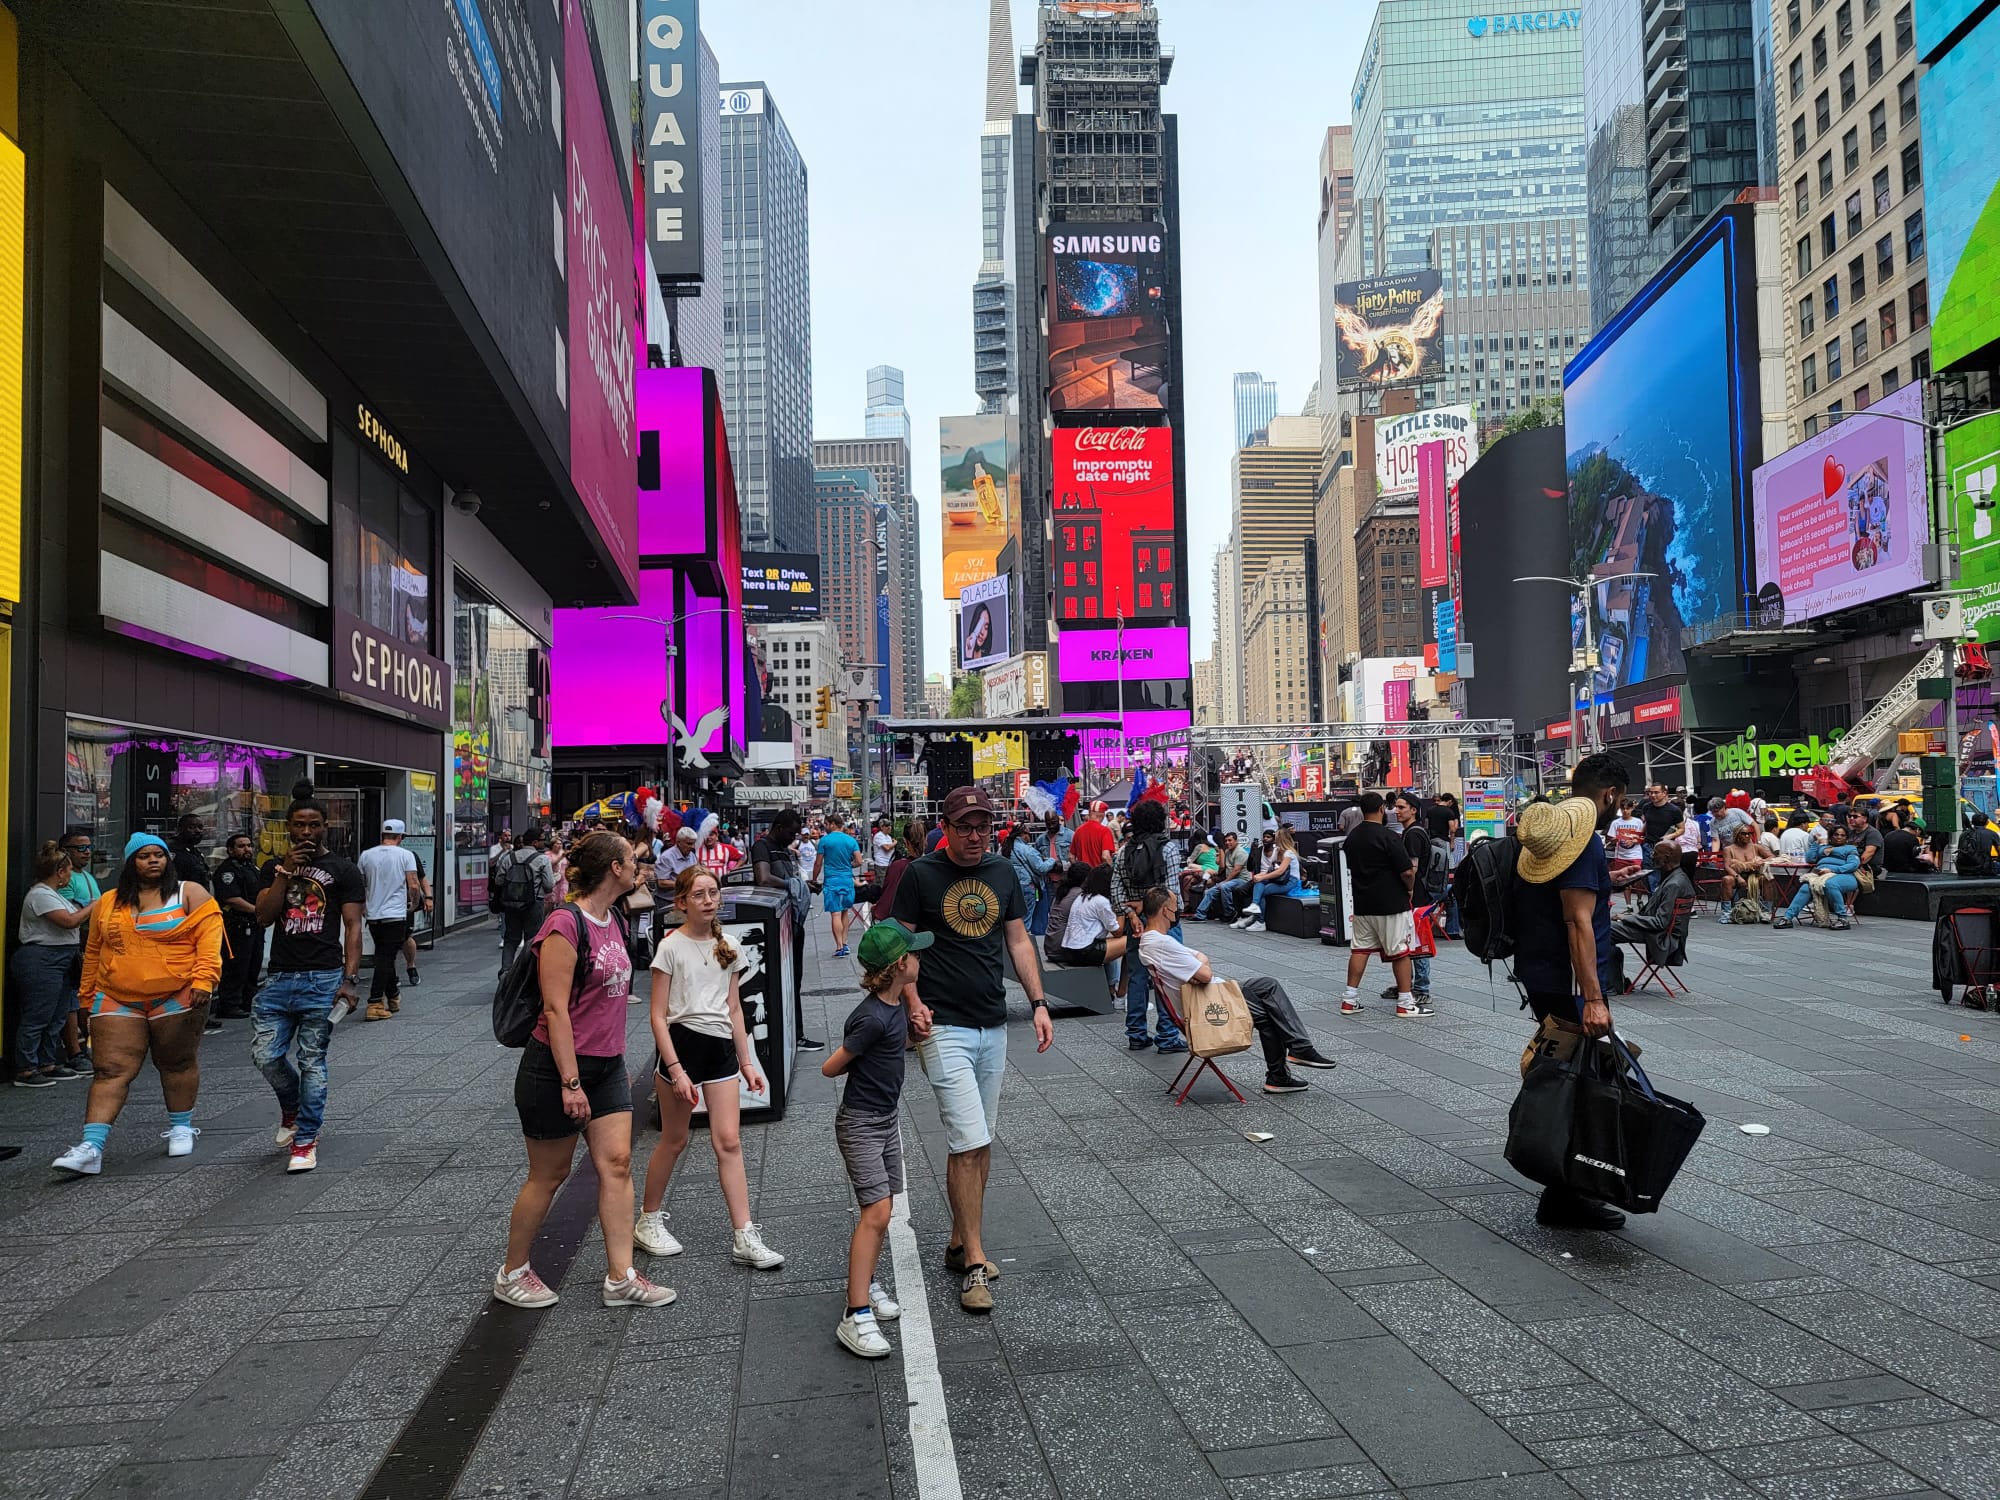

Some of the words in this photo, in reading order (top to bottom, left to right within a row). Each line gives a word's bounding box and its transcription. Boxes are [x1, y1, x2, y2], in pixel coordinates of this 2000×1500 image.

[647, 0, 686, 242] QUARE
[572, 141, 608, 339] PRICE
[1052, 235, 1162, 254] SAMSUNG
[1374, 276, 1418, 288] BROADWAY
[1356, 292, 1387, 315] Harry
[1387, 288, 1423, 312] Potter
[610, 277, 635, 423] LOCK
[587, 300, 629, 459] GUARANTEE
[357, 404, 408, 474] SEPHORA
[1074, 426, 1149, 452] Coca-Cola
[1385, 413, 1430, 445] LITTLE
[1433, 413, 1468, 433] SHOP
[1073, 459, 1153, 472] impromptu
[1386, 436, 1468, 486] HORRS
[1076, 470, 1110, 482] date
[1113, 469, 1151, 484] night
[1803, 519, 1810, 528] to
[1826, 506, 1837, 517] this
[741, 567, 764, 578] Text
[766, 568, 779, 579] OR
[781, 569, 808, 580] Drive.
[951, 571, 997, 586] JANEIR
[1781, 564, 1805, 580] Anything
[766, 580, 775, 590] Is
[777, 580, 790, 591] No
[961, 578, 1005, 604] OLAPLEX
[1805, 598, 1825, 613] Happy
[1825, 584, 1867, 607] Anniversary
[1090, 648, 1154, 662] KRAKEN
[351, 630, 443, 713] SEPHORA
[1032, 655, 1045, 706] HELLO!
[1716, 725, 1757, 780] pelé
[1305, 767, 1320, 793] tkts
[1468, 780, 1489, 789] TSQ
[1724, 769, 1752, 779] SOCCER
[735, 789, 806, 802] SWAROVSKI
[1573, 1153, 1626, 1177] SKECHERS
